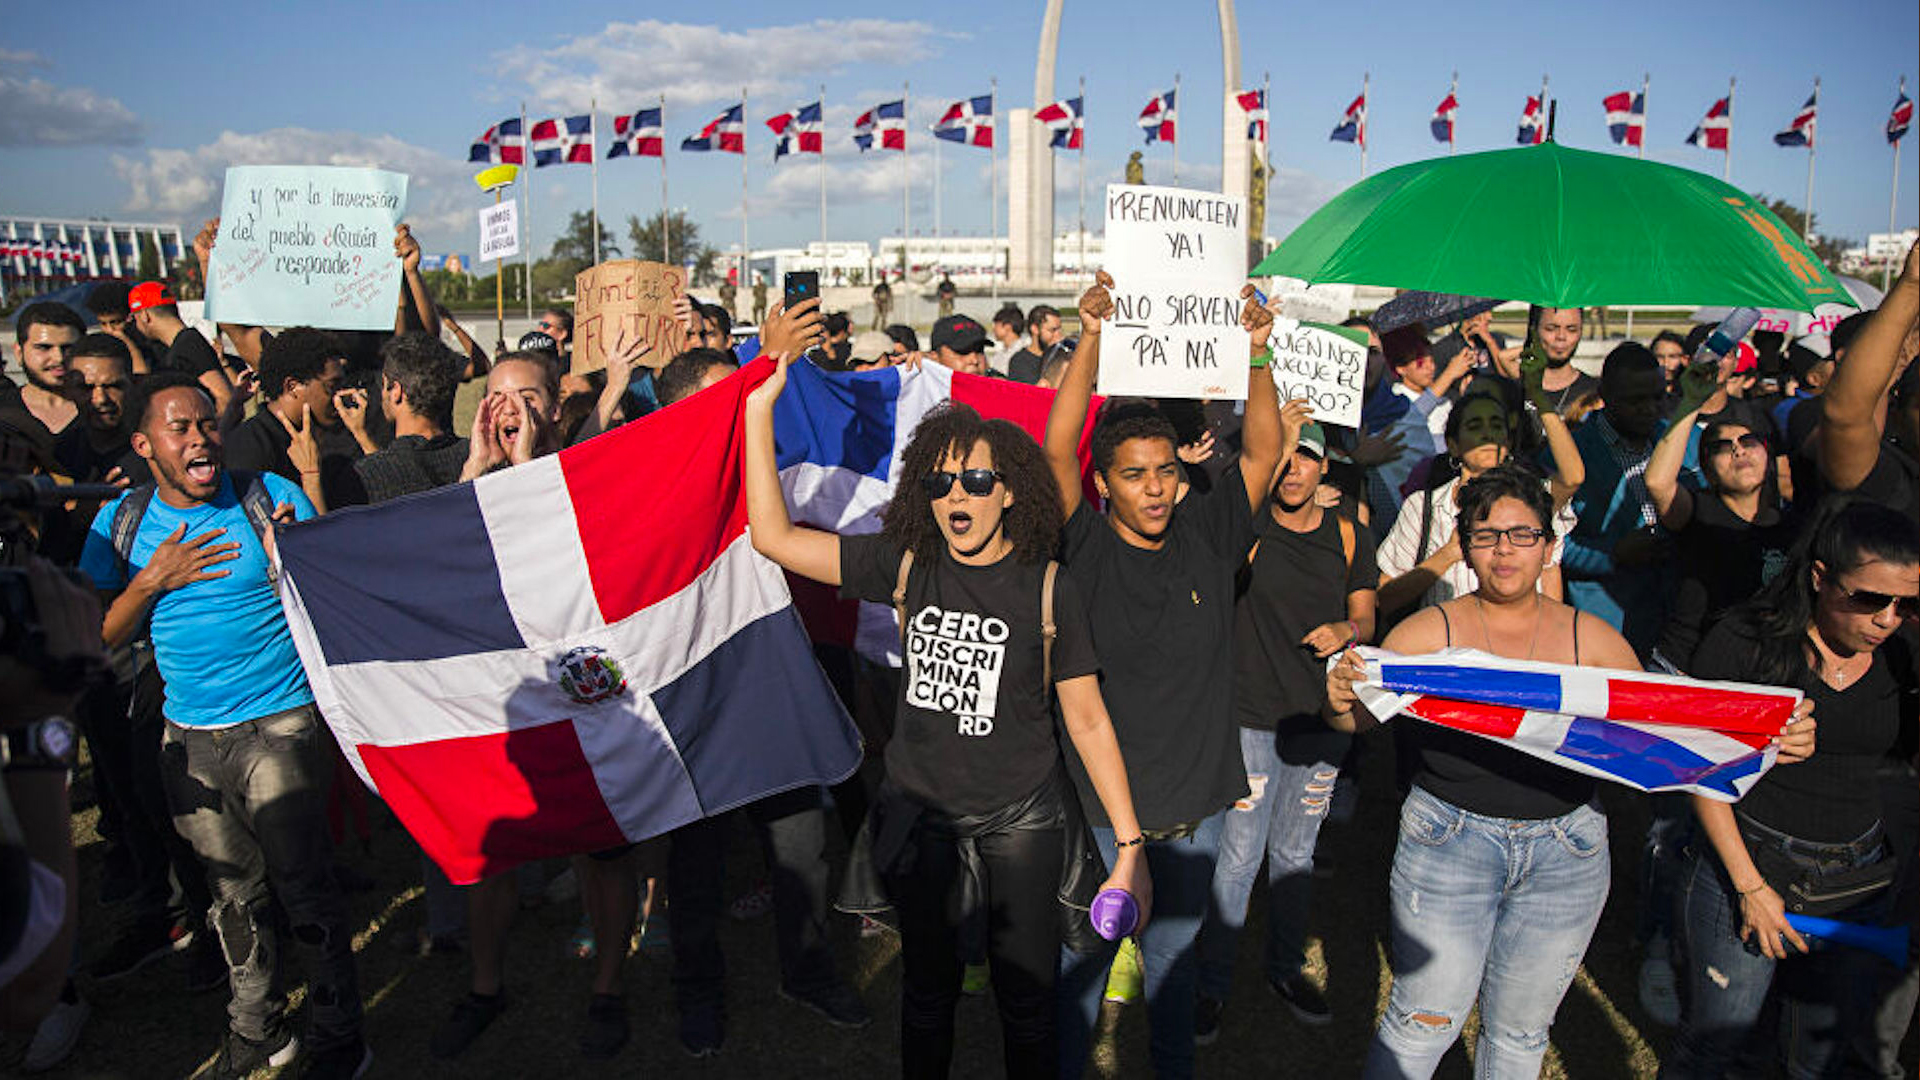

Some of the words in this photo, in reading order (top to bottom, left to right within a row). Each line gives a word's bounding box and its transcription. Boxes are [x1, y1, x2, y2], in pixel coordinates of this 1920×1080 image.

[275, 187, 298, 217] por
[308, 181, 320, 205] la
[231, 212, 256, 241] del
[269, 220, 315, 253] pueblo
[1115, 295, 1151, 321] NO
[1163, 295, 1240, 327] SIRVEN
[1329, 341, 1361, 373] NOS
[1337, 369, 1361, 391] EL
[914, 605, 1010, 643] CERO
[911, 635, 997, 671] DISCRI
[917, 658, 981, 691] MINA
[915, 681, 979, 713] CIÓN
[958, 715, 994, 736] RD
